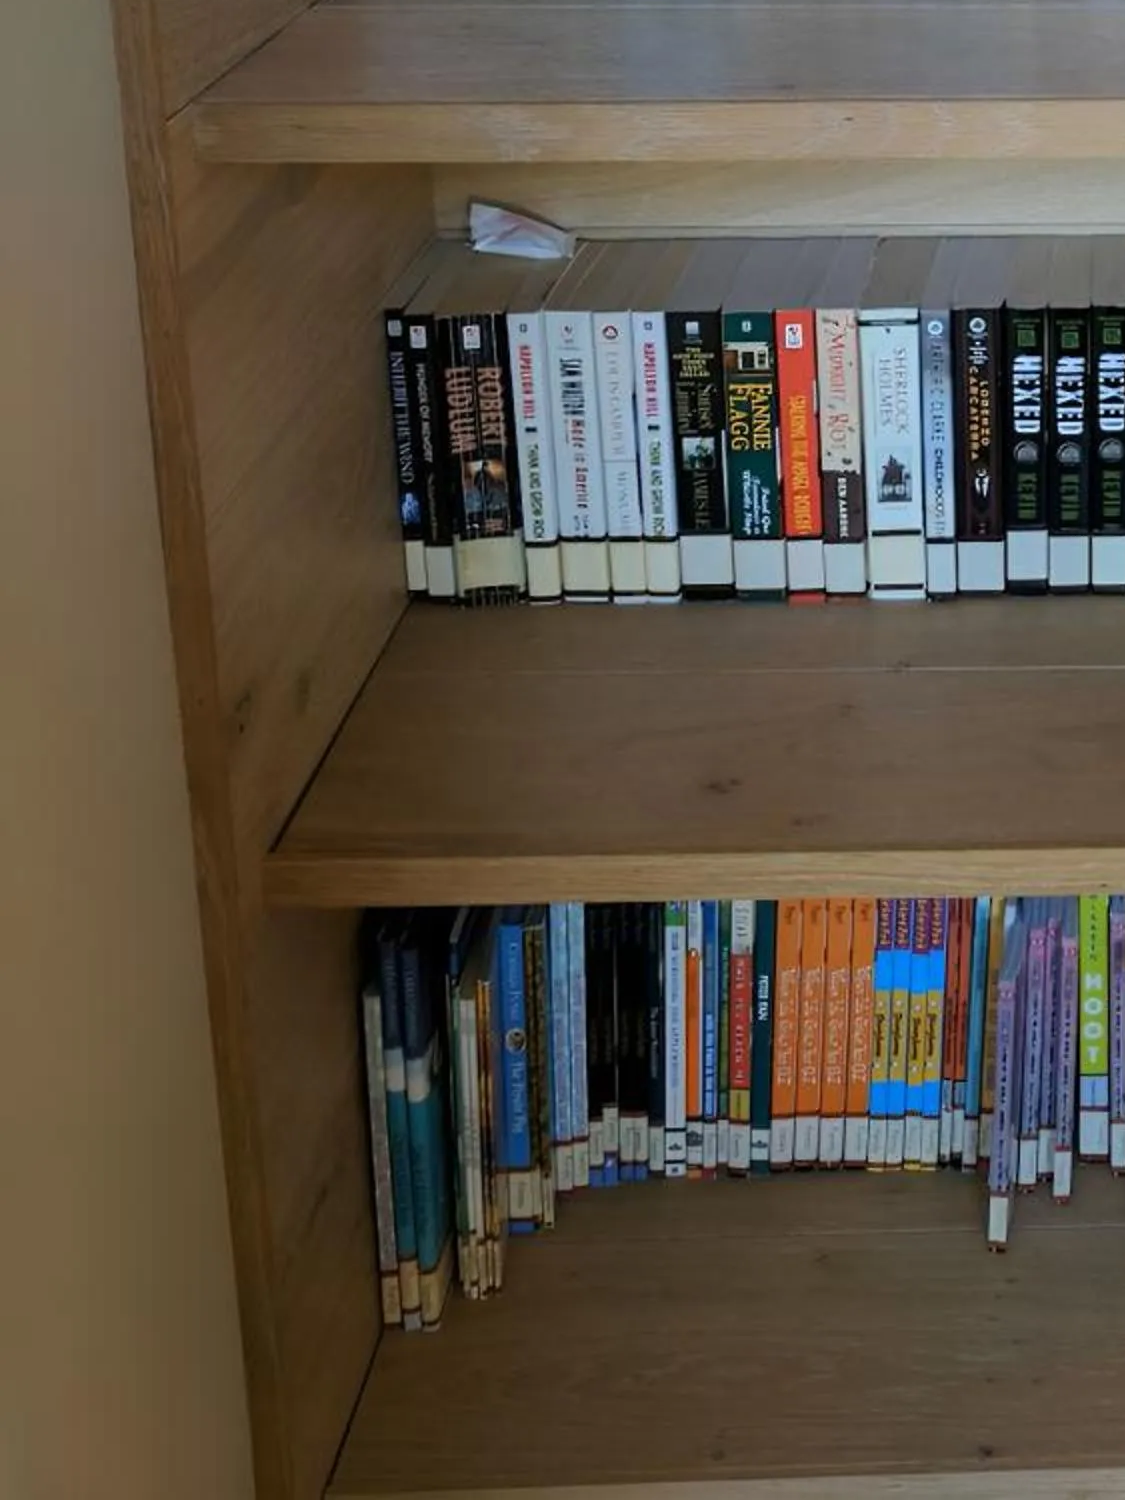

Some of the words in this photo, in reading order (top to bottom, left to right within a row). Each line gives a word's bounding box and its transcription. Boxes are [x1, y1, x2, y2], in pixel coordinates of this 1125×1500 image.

[444, 366, 477, 455] LUDLUM
[477, 365, 507, 448] ROBERT
[728, 382, 752, 451] FLAGG
[750, 382, 773, 451] FANNIE
[879, 358, 893, 427] HOLMES
[893, 346, 910, 435] SHERLOCK
[1012, 355, 1043, 434] HEXED
[1056, 355, 1086, 435] HEXED
[829, 412, 849, 451] RIOT
[1084, 973, 1103, 1063] HOOT
